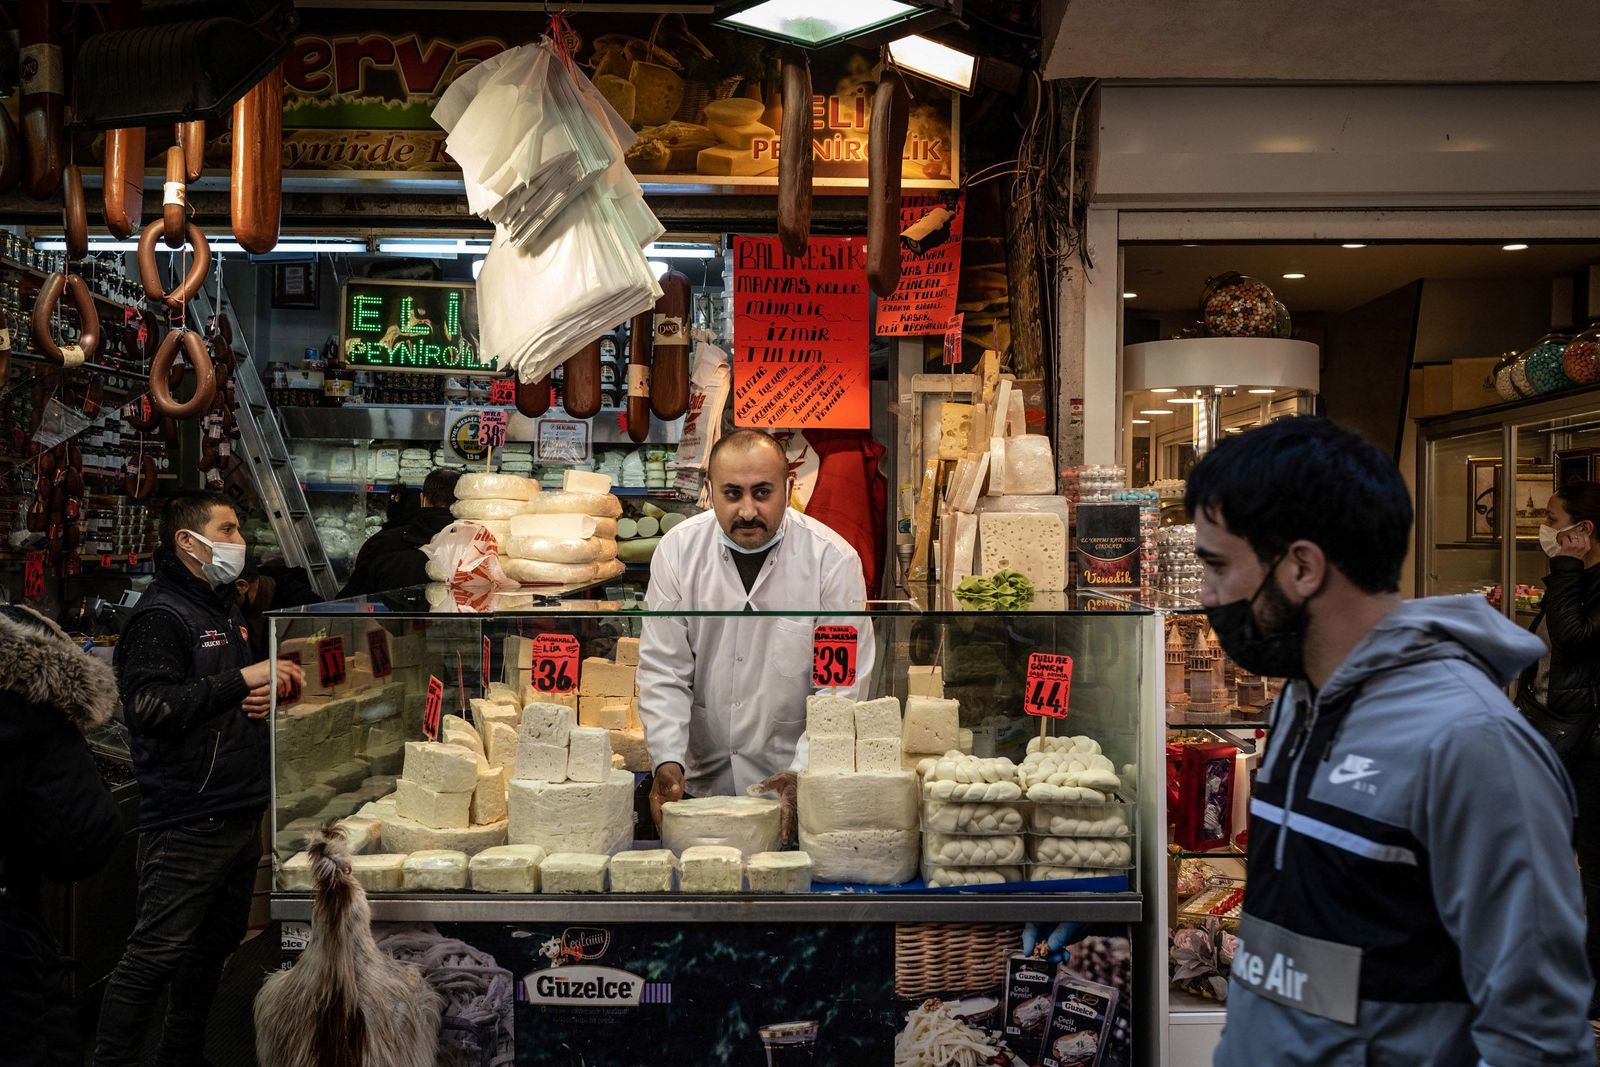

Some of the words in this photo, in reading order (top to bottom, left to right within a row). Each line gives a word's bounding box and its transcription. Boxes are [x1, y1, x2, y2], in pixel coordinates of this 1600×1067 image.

[737, 275, 811, 293] MANYAS
[767, 322, 829, 341] İZMİR
[480, 424, 500, 447] 38
[1084, 569, 1133, 585] Venedik
[538, 659, 572, 691] 36
[818, 646, 848, 685] 39
[1031, 681, 1061, 713] 44
[1352, 781, 1377, 796] AIR
[1265, 952, 1308, 1001] Air
